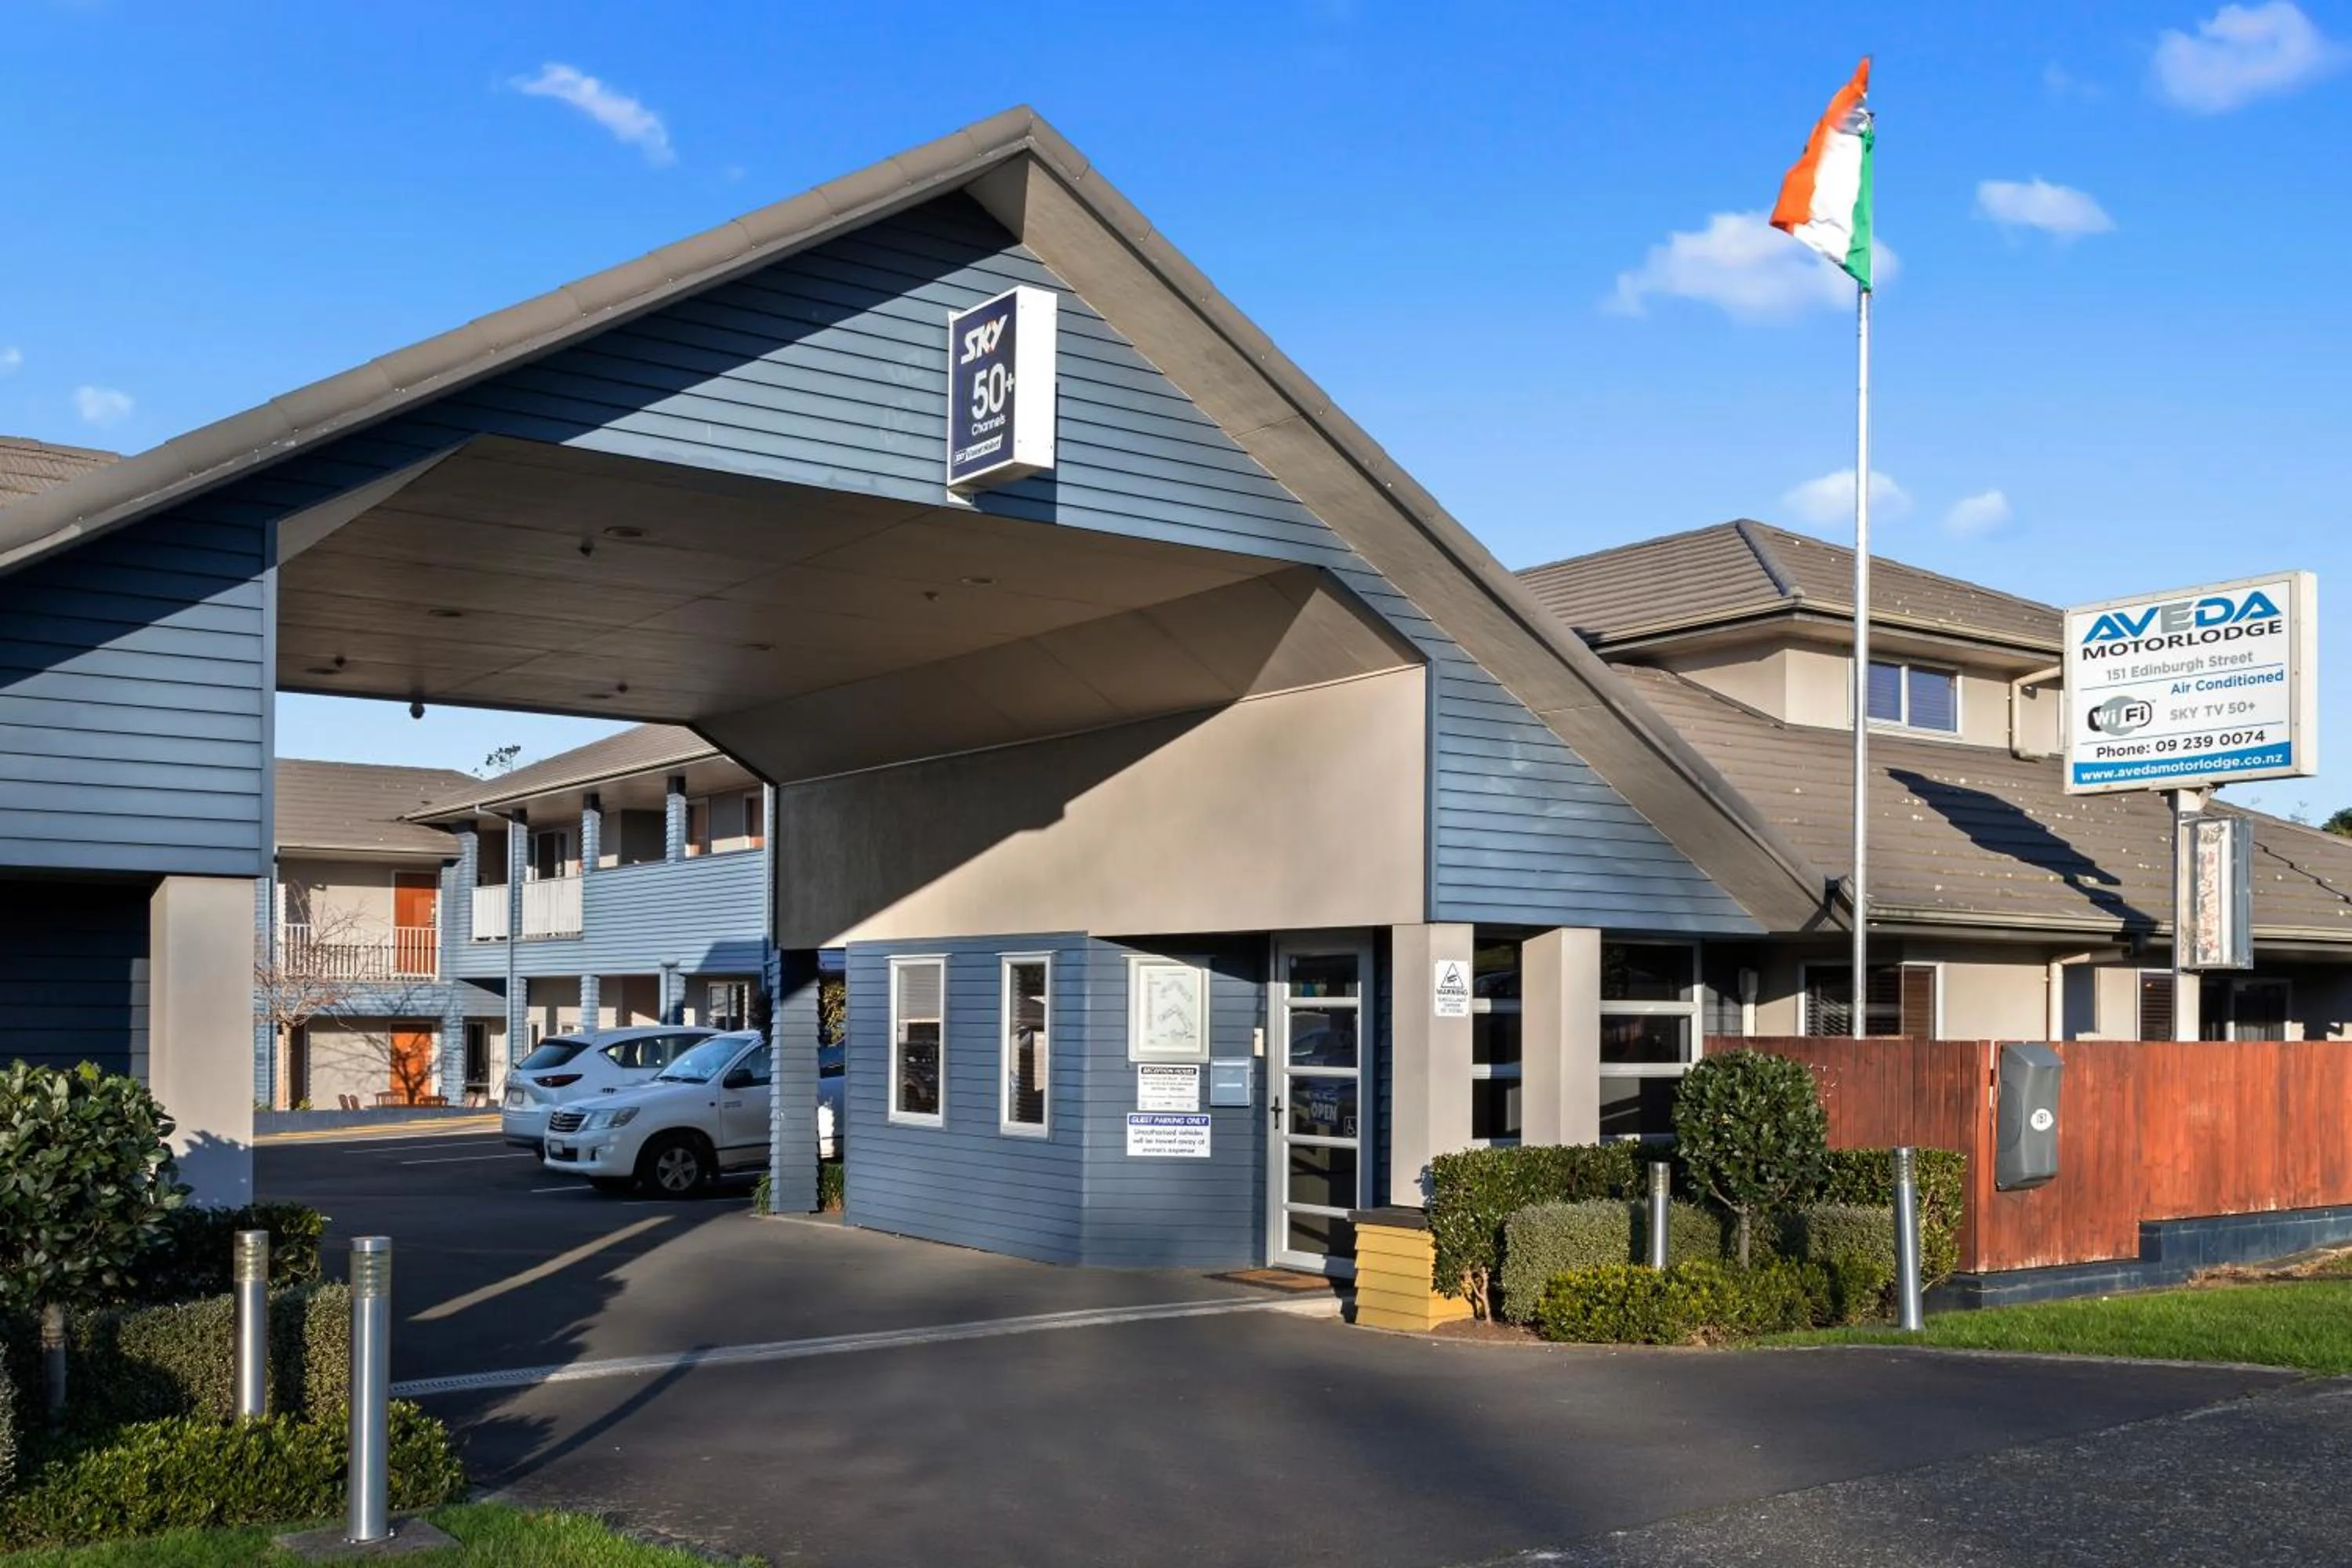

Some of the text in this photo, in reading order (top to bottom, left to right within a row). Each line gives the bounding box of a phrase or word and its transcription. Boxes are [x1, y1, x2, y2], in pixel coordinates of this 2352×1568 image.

[960, 314, 1008, 365] SKY
[971, 363, 1015, 419] 50+
[971, 414, 1006, 436] Channels
[2082, 590, 2283, 644] AVEDA
[2082, 619, 2283, 660] MOTORLODGE
[2107, 652, 2253, 681] 151 Edinburgh Street
[2170, 669, 2284, 695] Air Conditioned
[2169, 701, 2256, 720] SKY TV 50+
[2096, 730, 2266, 758] Phone: 09 239 0074
[2081, 753, 2284, 781] www.avedamotorlodge.co.nz
[1153, 1116, 1185, 1124] PARKING
[1186, 1116, 1207, 1125] ONLY
[1311, 1102, 1338, 1121] OPEN
